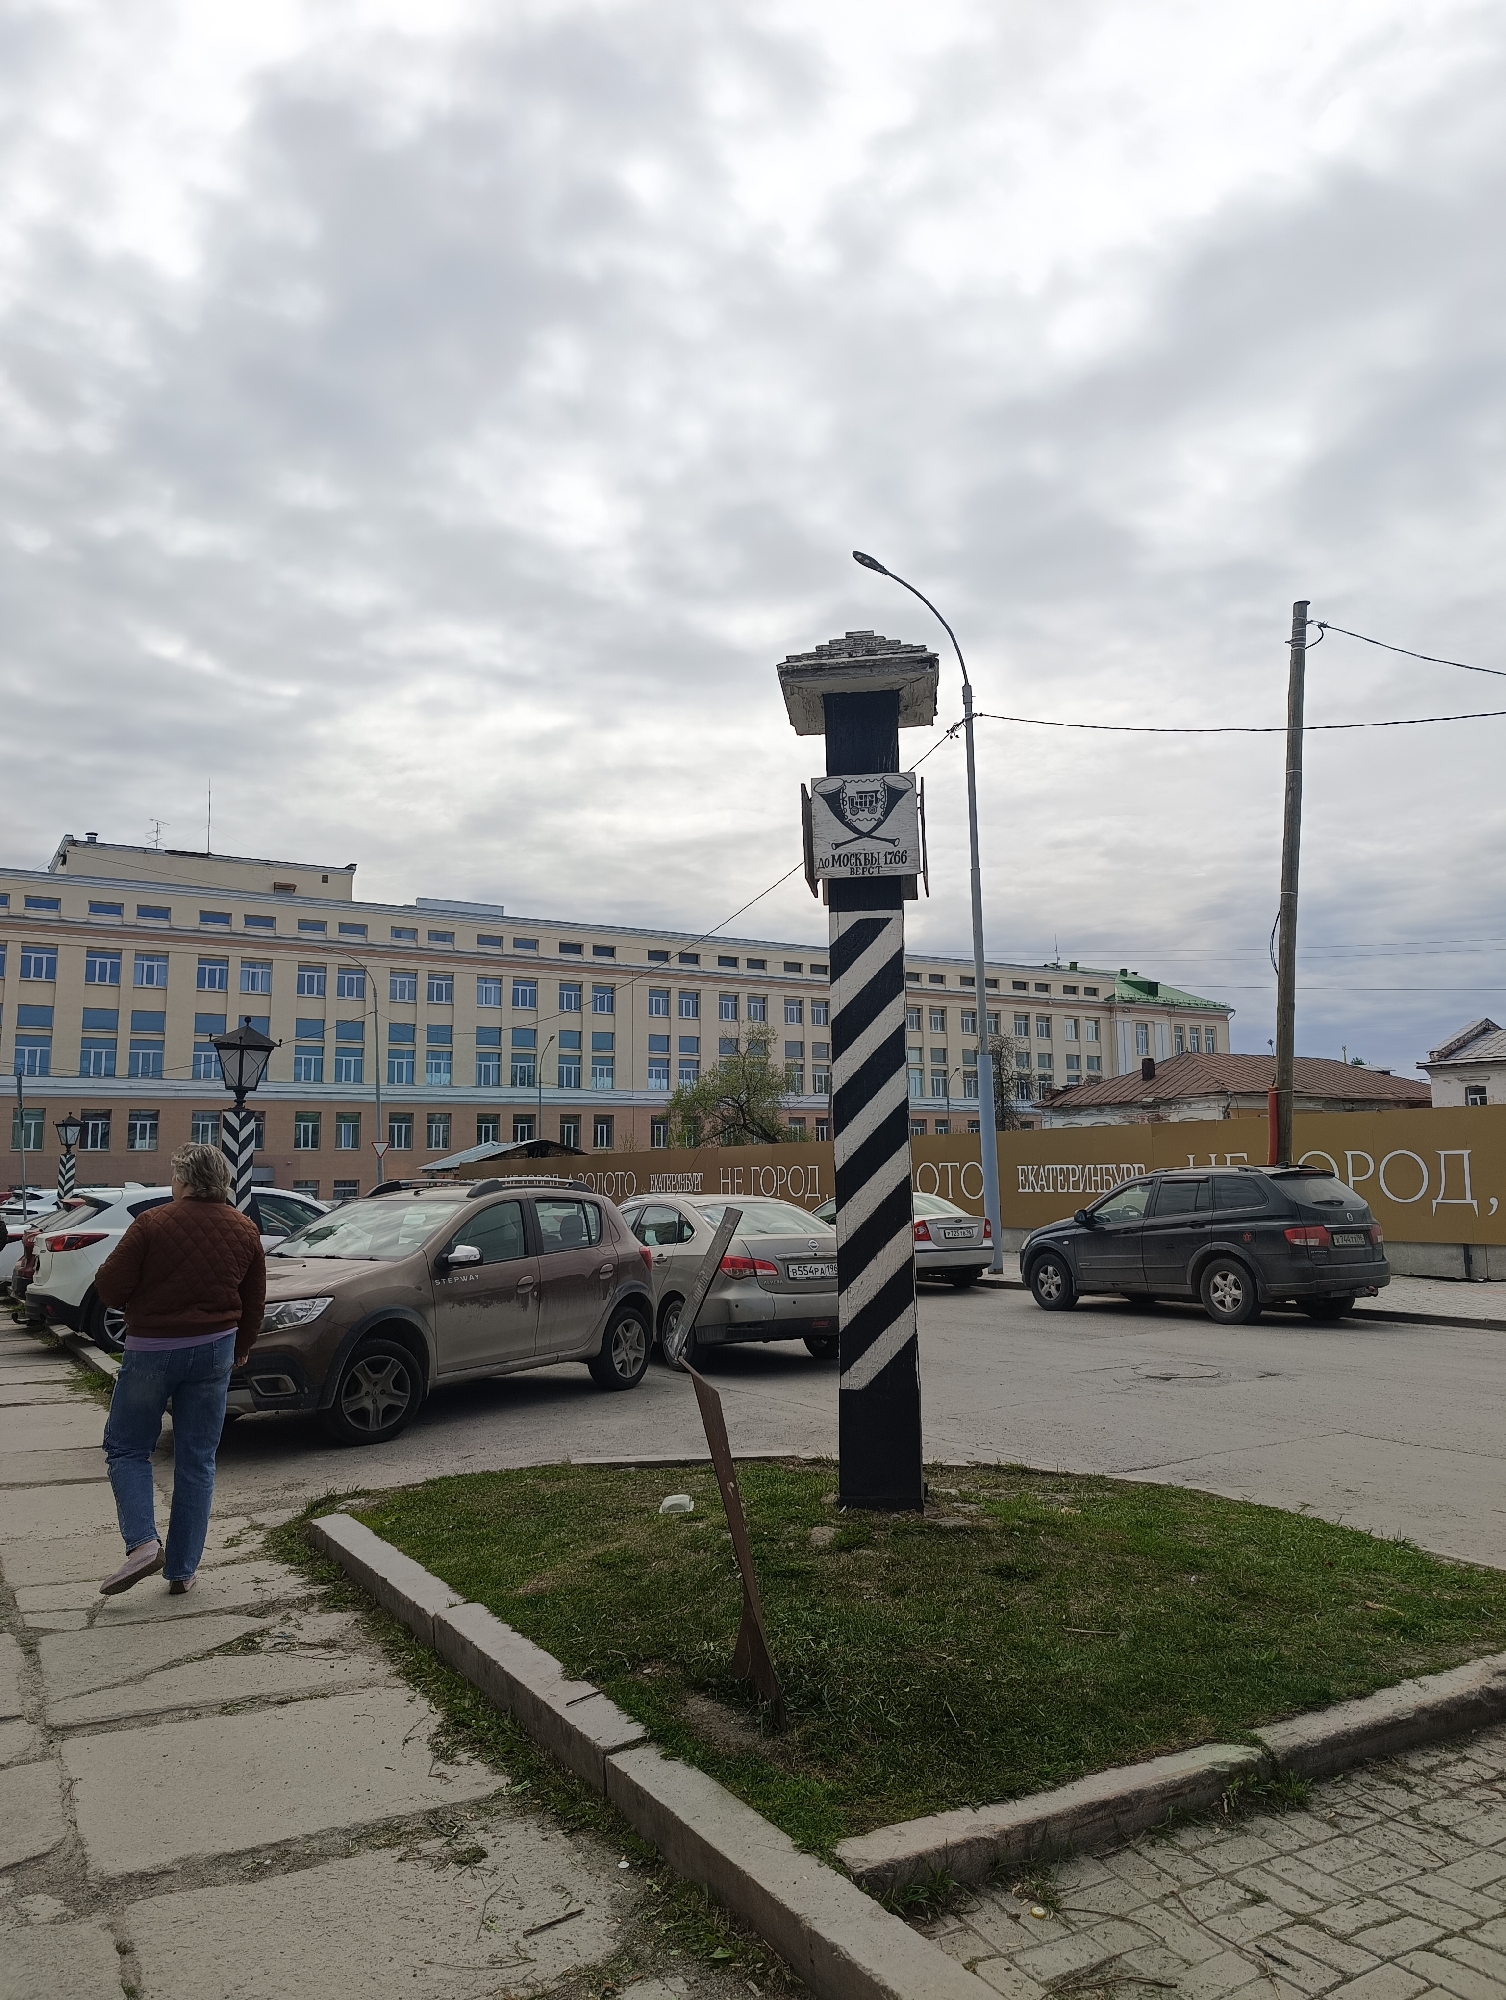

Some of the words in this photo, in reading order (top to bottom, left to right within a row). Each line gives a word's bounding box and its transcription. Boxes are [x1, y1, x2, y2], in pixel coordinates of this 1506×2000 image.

[831, 852, 881, 868] МОСКВЫ
[883, 850, 908, 865] 1766
[850, 865, 882, 875] ВЕРСТ
[650, 1173, 703, 1193] ЕКАТЕРИНБУРГ
[720, 1167, 744, 1195] НЕ
[792, 1265, 826, 1276] В554РА
[434, 1274, 479, 1286] STEPWAY
